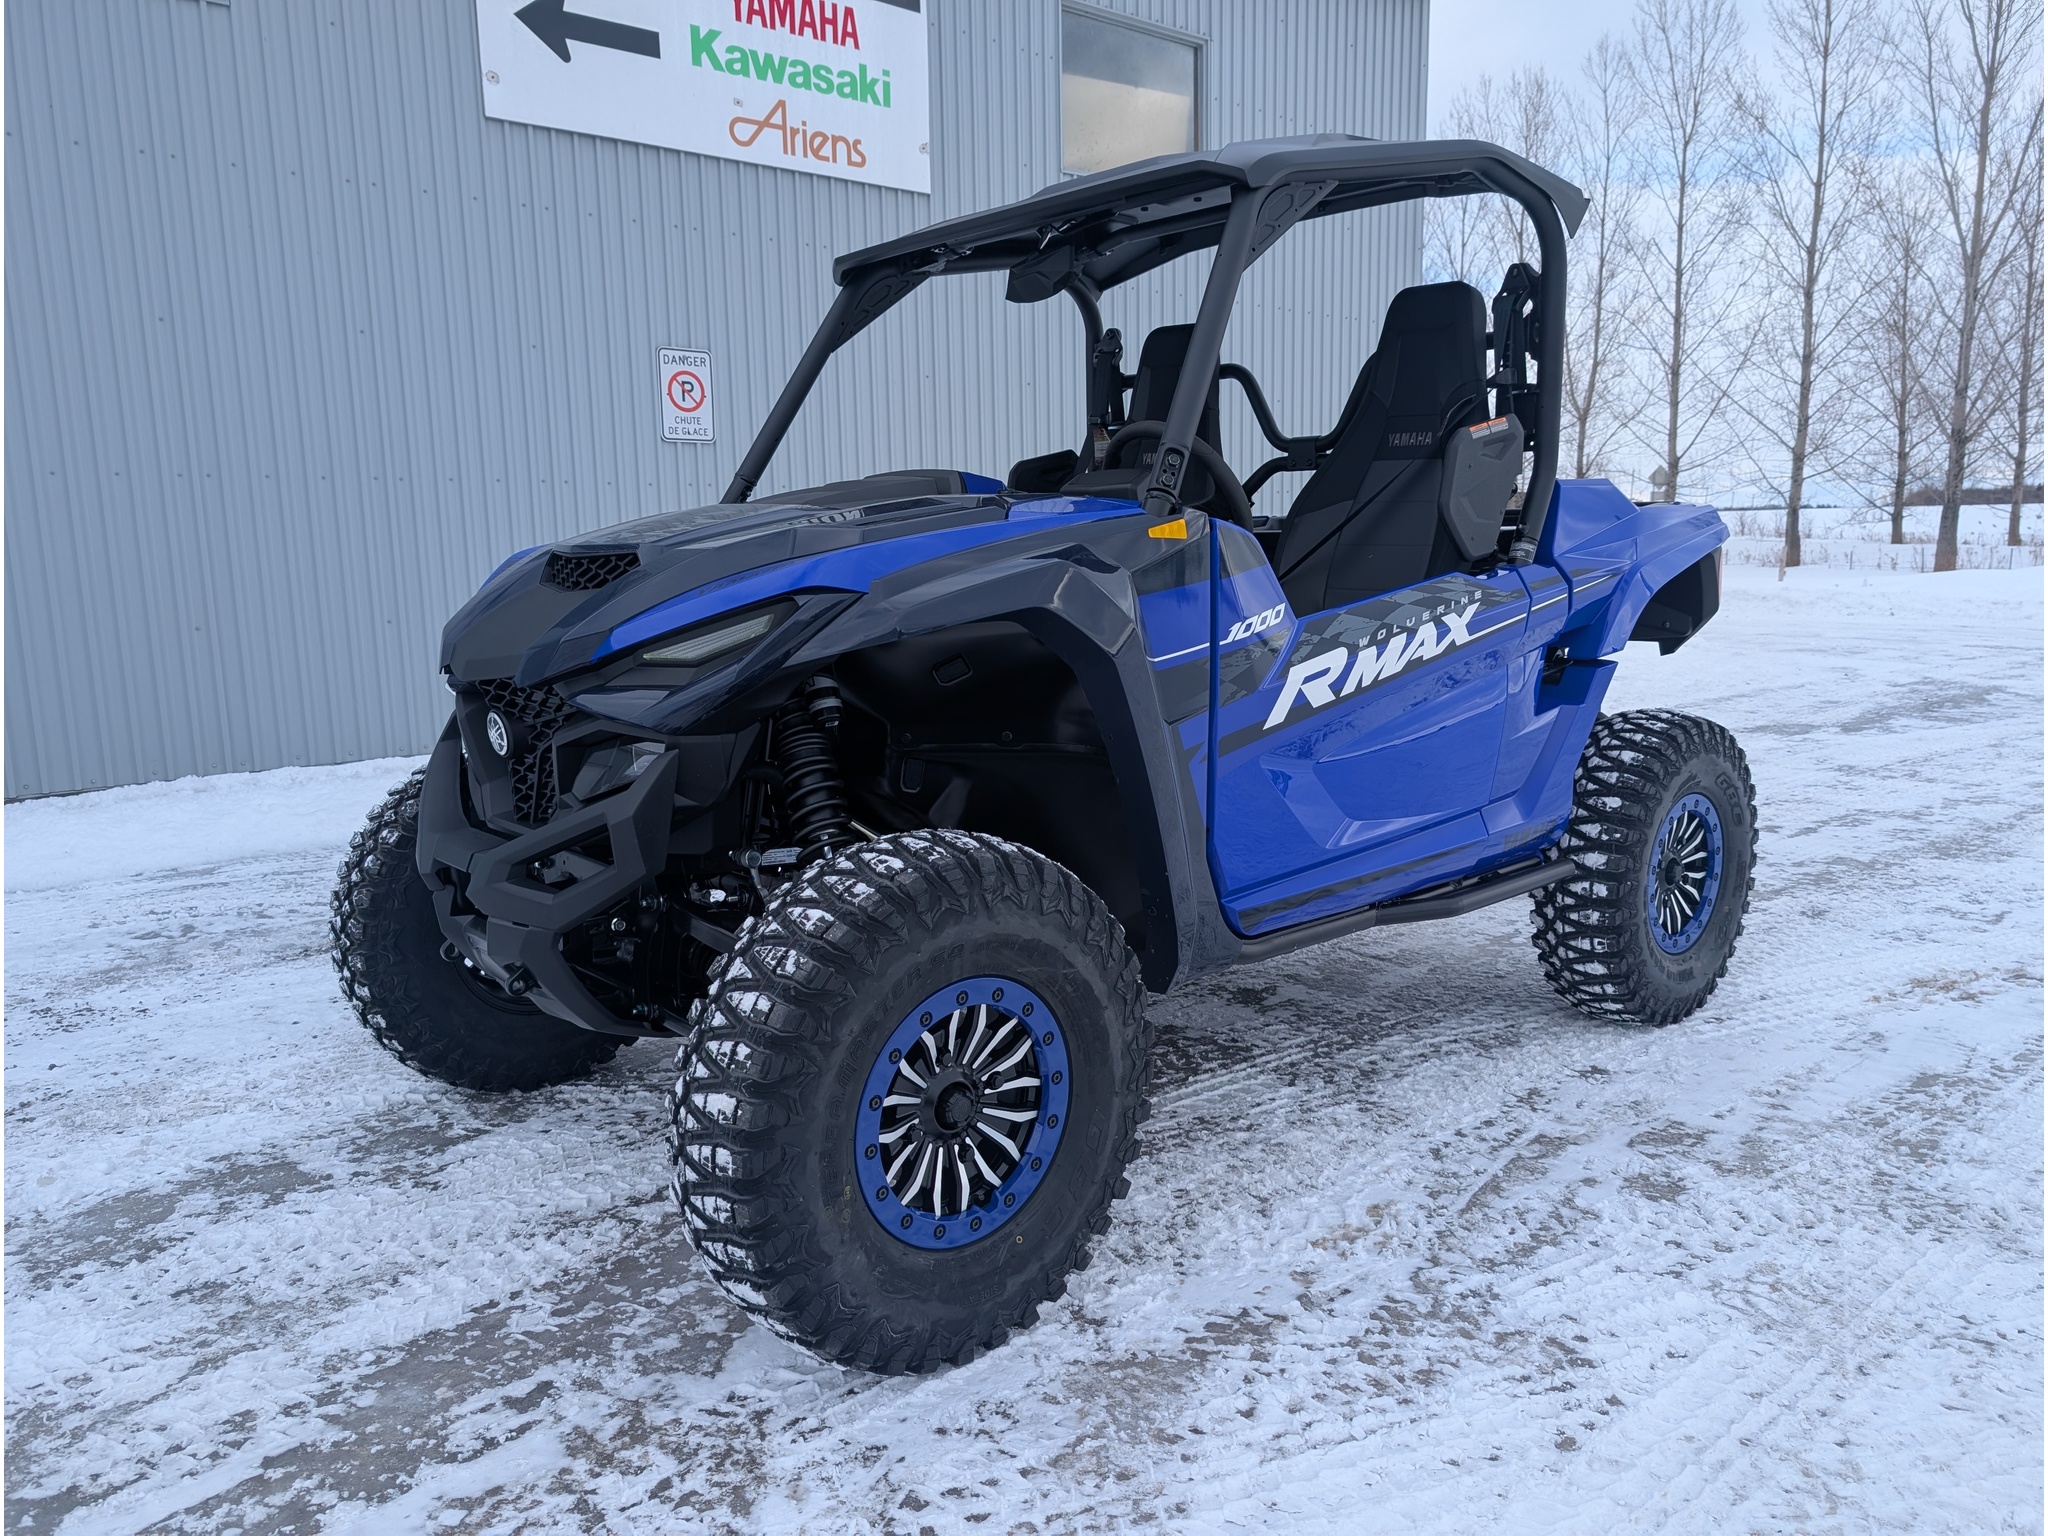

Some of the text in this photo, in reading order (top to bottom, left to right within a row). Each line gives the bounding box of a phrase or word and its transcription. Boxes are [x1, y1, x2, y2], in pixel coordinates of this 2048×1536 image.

[689, 24, 891, 108] Kawasaki
[728, 99, 867, 168] Ariens
[663, 354, 707, 368] DANGER
[668, 427, 709, 436] DE GLACE
[674, 416, 702, 425] CHUTE
[1388, 431, 1433, 447] YAMAHA
[1219, 602, 1286, 646] 1000
[1262, 601, 1481, 730] RMAX
